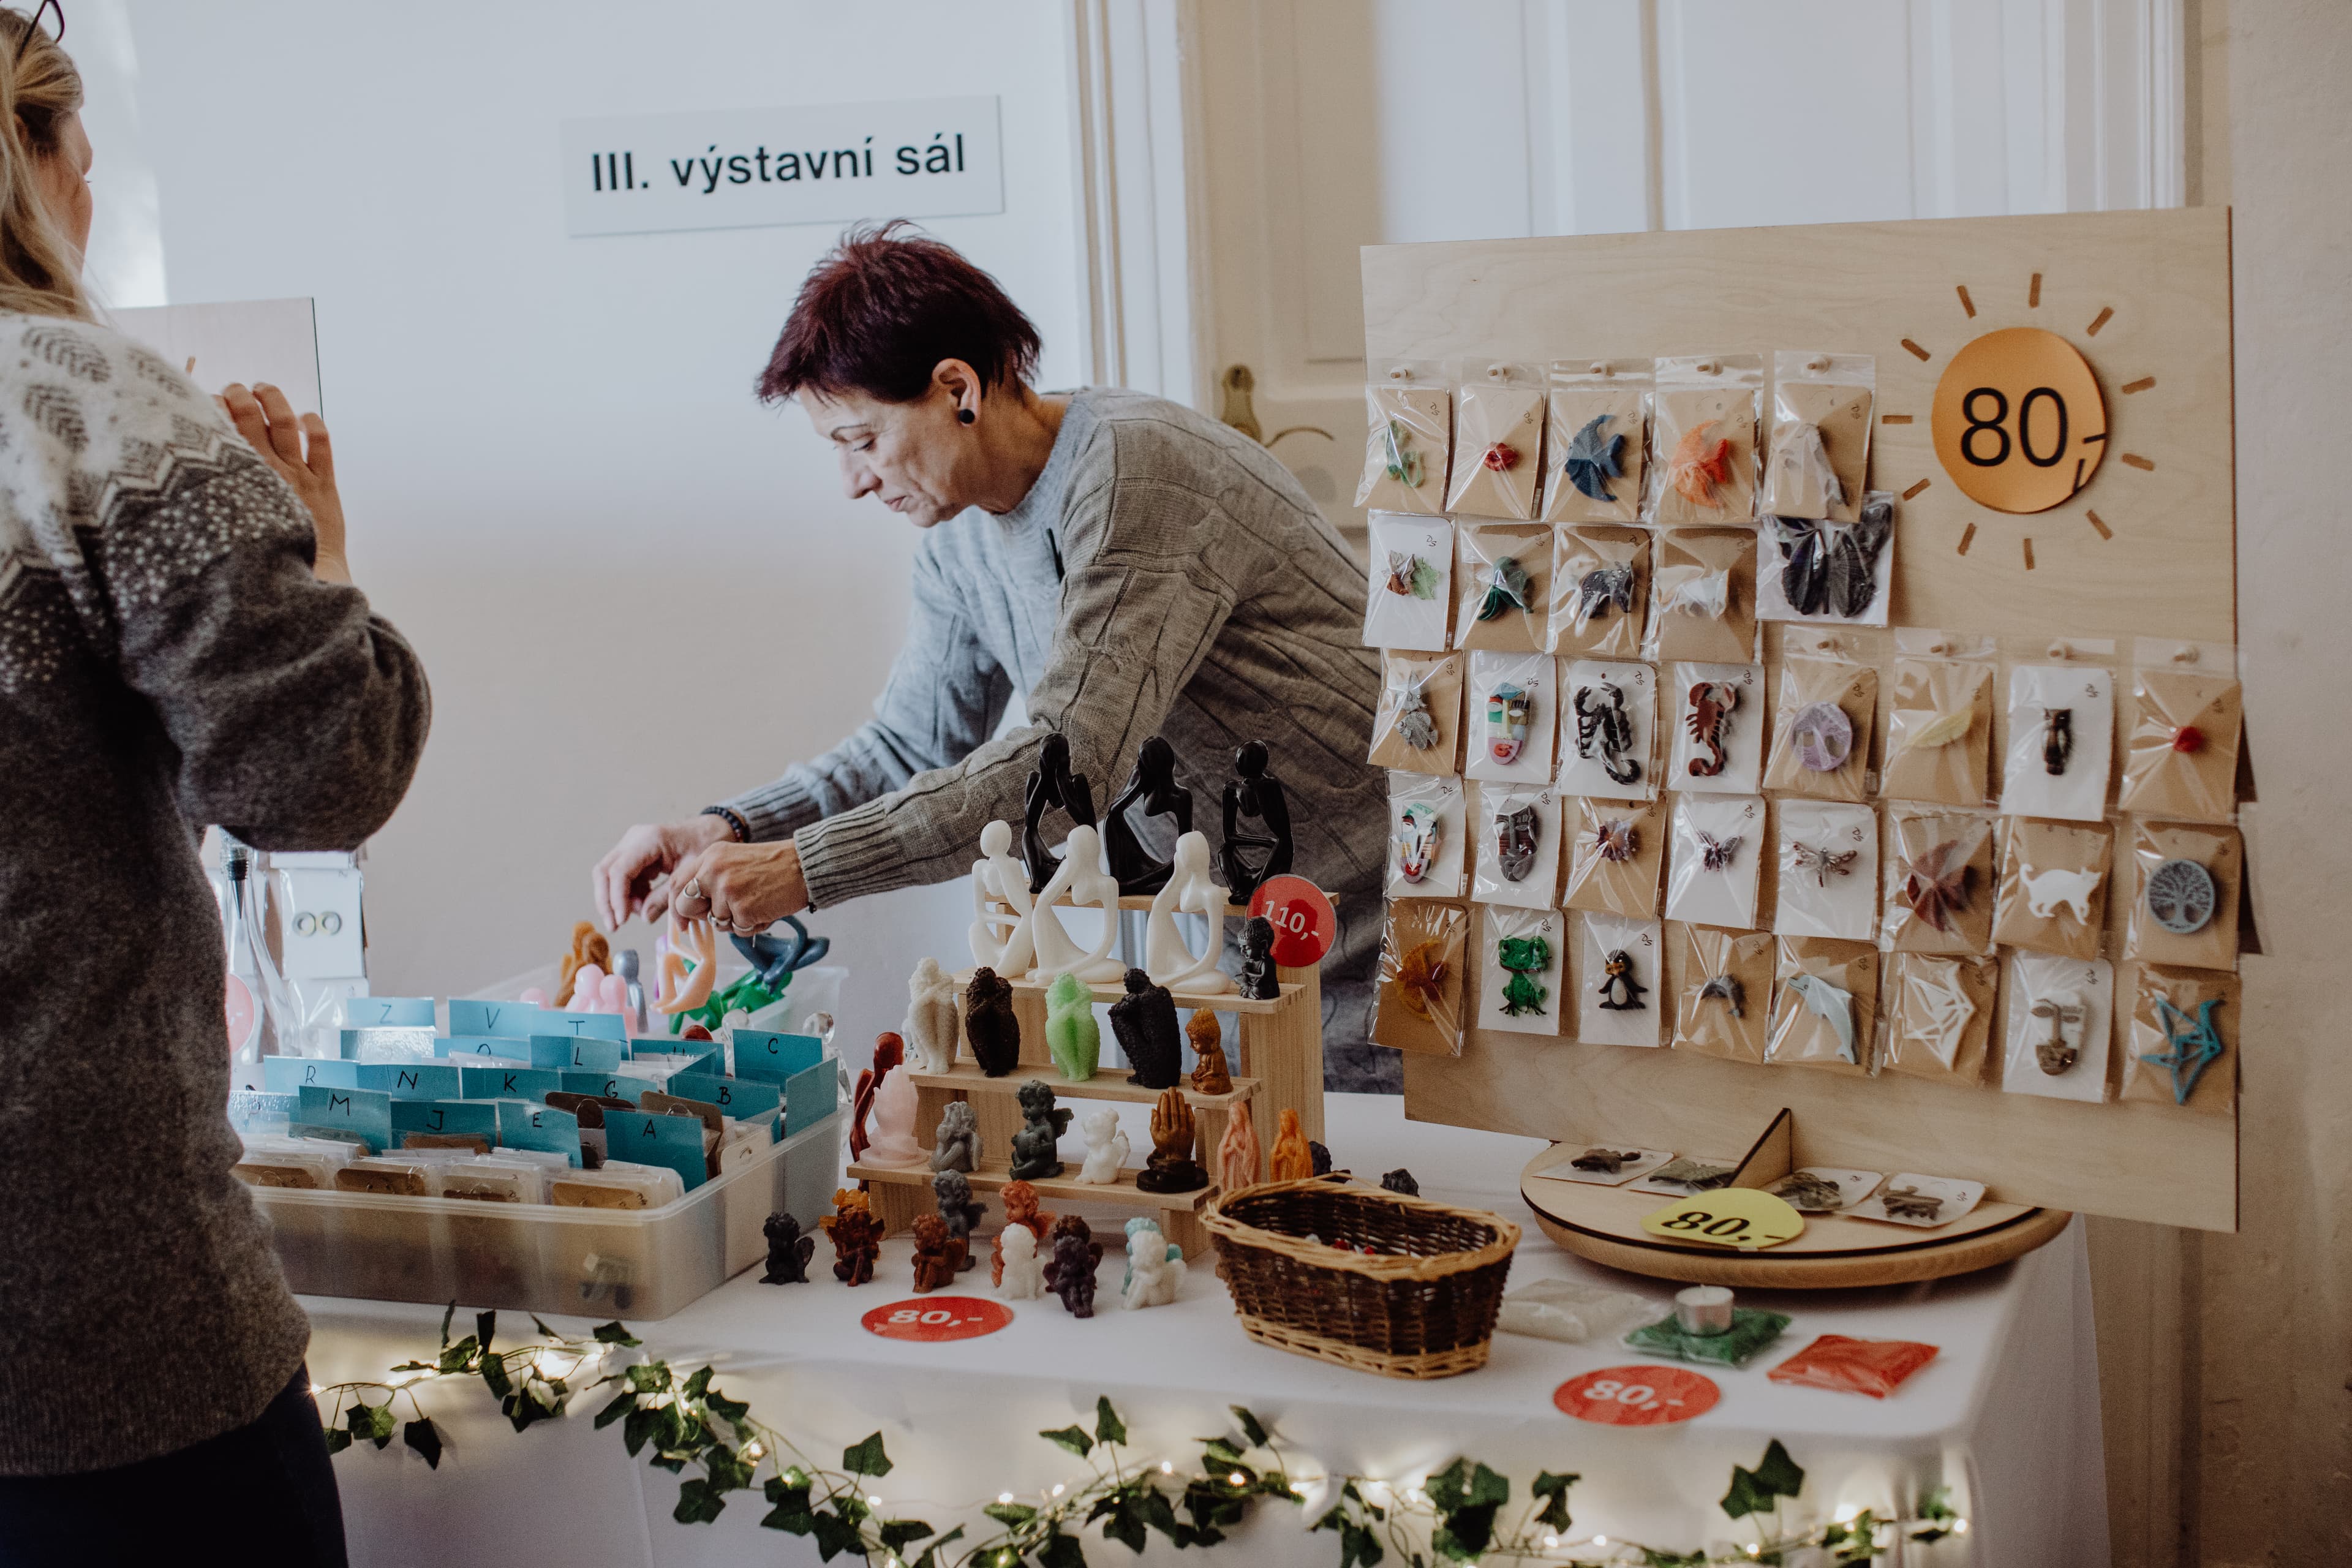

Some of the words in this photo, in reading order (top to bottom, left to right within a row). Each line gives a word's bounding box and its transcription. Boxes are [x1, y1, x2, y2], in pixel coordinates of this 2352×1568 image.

[592, 151, 649, 192] III.
[671, 135, 874, 195] výstavní
[895, 131, 965, 176] sál
[1262, 900, 1319, 941] 110,-
[380, 1004, 392, 1024] Z
[485, 1006, 500, 1029] V
[568, 1020, 585, 1036] T
[767, 1038, 778, 1054] C
[575, 1047, 582, 1066] L
[306, 1065, 316, 1084] R
[397, 1070, 418, 1090] N
[503, 1072, 516, 1092] K
[604, 1080, 619, 1099] G
[716, 1086, 731, 1105] B
[329, 1093, 350, 1116] M
[426, 1110, 444, 1131] J
[532, 1112, 543, 1128] E
[643, 1119, 656, 1139] A
[1661, 1212, 1785, 1243] 80,-
[888, 1310, 983, 1327] 80,-
[1583, 1379, 1684, 1411] 80,-
